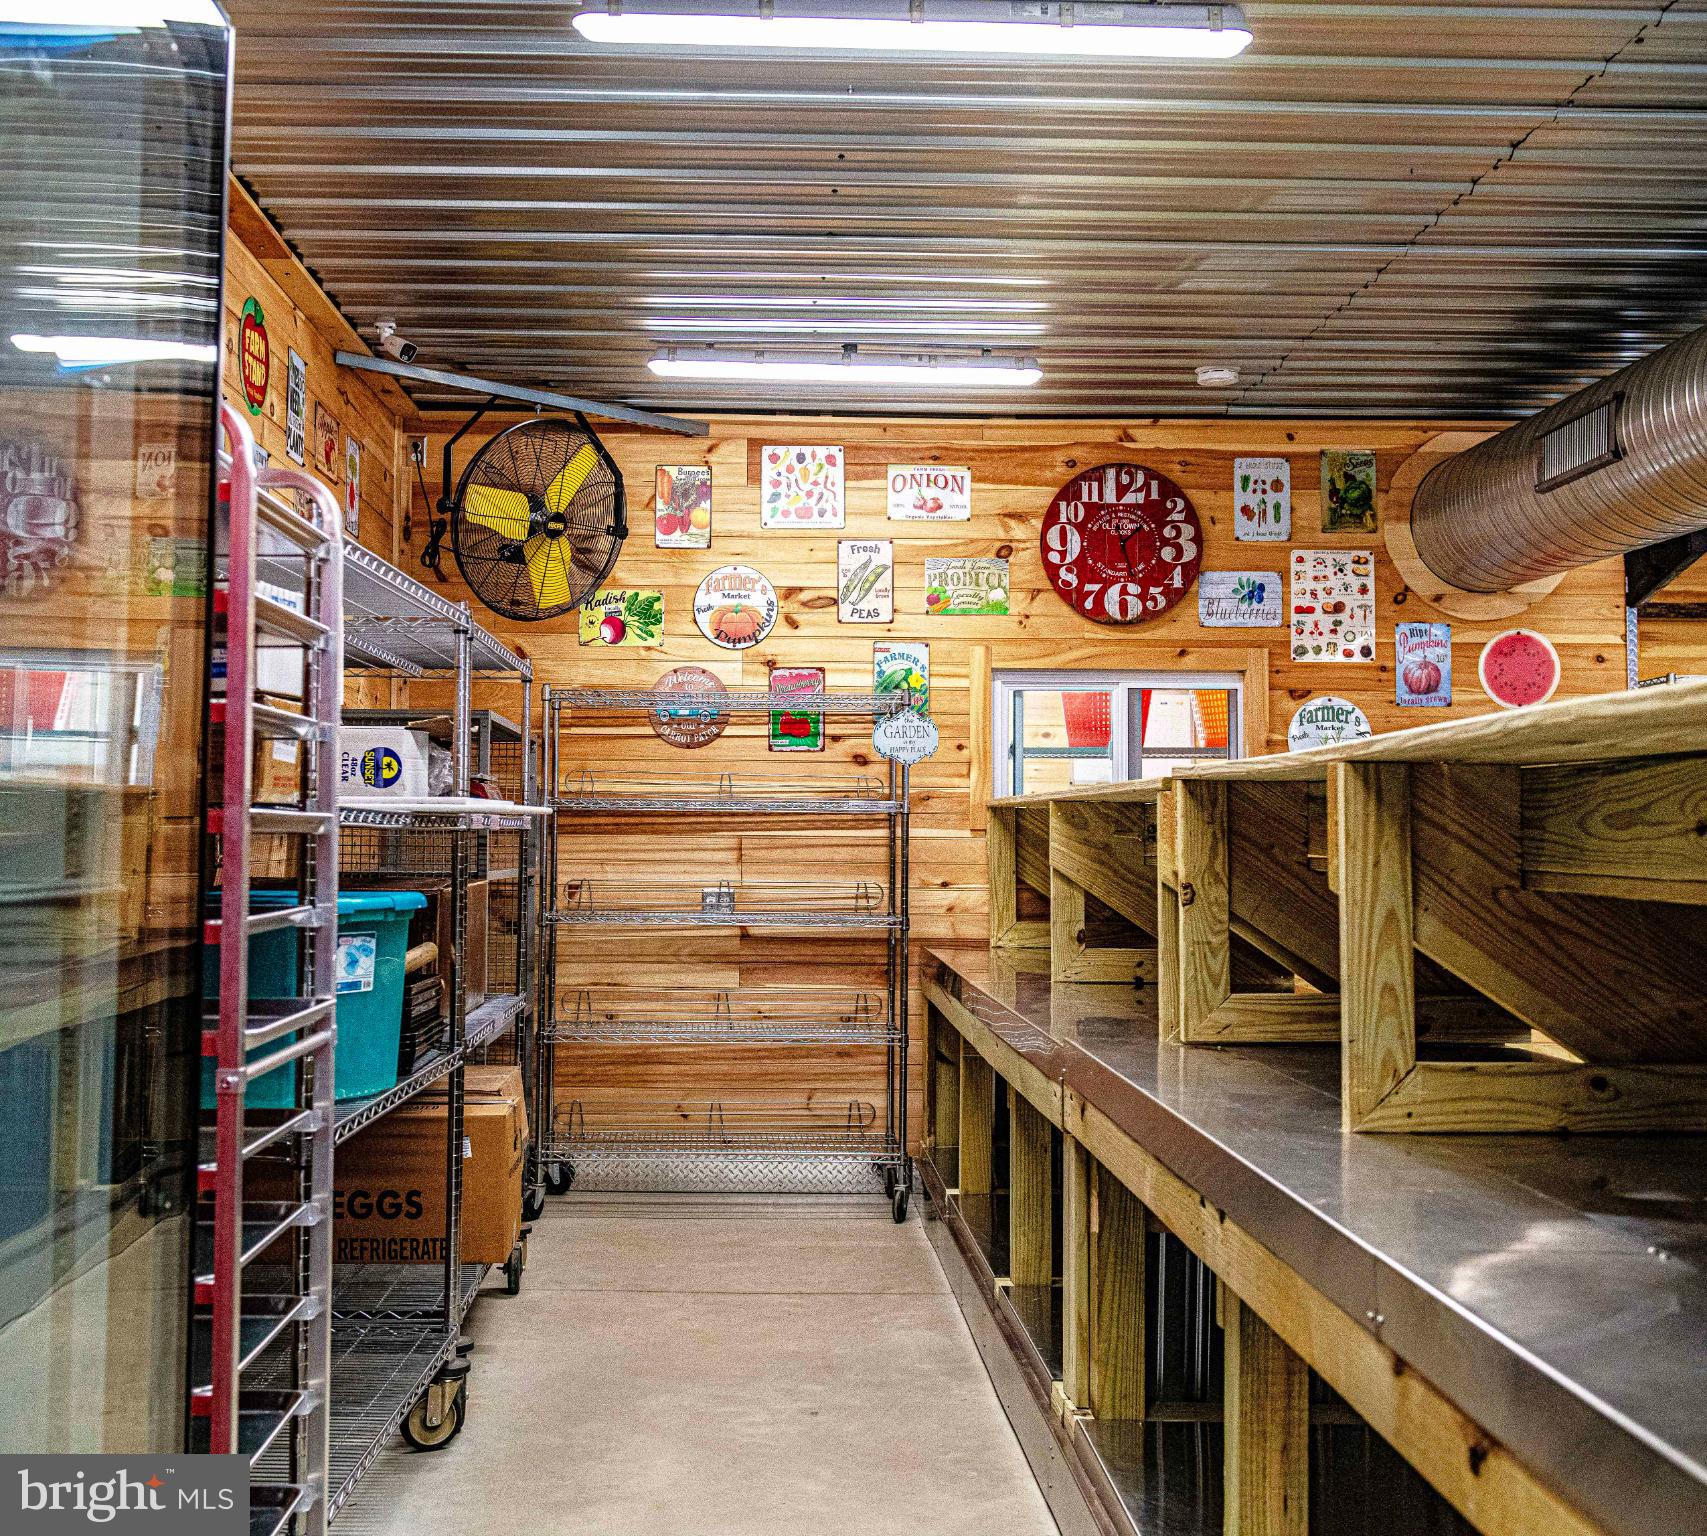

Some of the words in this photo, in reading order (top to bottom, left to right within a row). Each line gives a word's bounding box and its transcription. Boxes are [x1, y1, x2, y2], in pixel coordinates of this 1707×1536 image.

[245, 328, 266, 361] FARM
[244, 351, 266, 386] STAND
[892, 473, 965, 496] ONION
[1080, 481, 1104, 503] 11
[1102, 468, 1146, 504] 12
[1148, 480, 1161, 500] 1
[1057, 501, 1085, 523] 10
[1166, 497, 1186, 520] 2
[850, 544, 880, 555] Fresh
[1046, 523, 1081, 565] 9
[1160, 522, 1198, 564] 3
[927, 571, 1008, 588] PRODUCE
[1058, 565, 1078, 590] 8
[1096, 561, 1128, 576] STANDARD
[1164, 565, 1183, 588] 4
[705, 573, 768, 596] Farmer's
[721, 592, 751, 600] Market
[583, 591, 627, 611] Radish
[1083, 583, 1103, 610] 7
[1103, 582, 1143, 621] 6
[1146, 586, 1166, 611] 5
[850, 607, 880, 619] PEAS
[1203, 597, 1277, 620] Blueberries
[714, 597, 775, 644] Pumpkins
[1398, 624, 1448, 665] Pumpkins
[1409, 627, 1428, 639] Ripe
[665, 672, 716, 687] Welcome
[1400, 696, 1423, 705] locally
[1299, 705, 1361, 727] Farmer's
[660, 725, 690, 742] CARROT
[694, 725, 719, 742] PATCH
[883, 725, 930, 739] GARDEN
[889, 746, 909, 754] HAPPY
[341, 752, 350, 783] CLEAR
[363, 751, 376, 785] SUNSET
[333, 1190, 424, 1220] EGGS
[337, 1238, 446, 1261] REFRIGERATE
